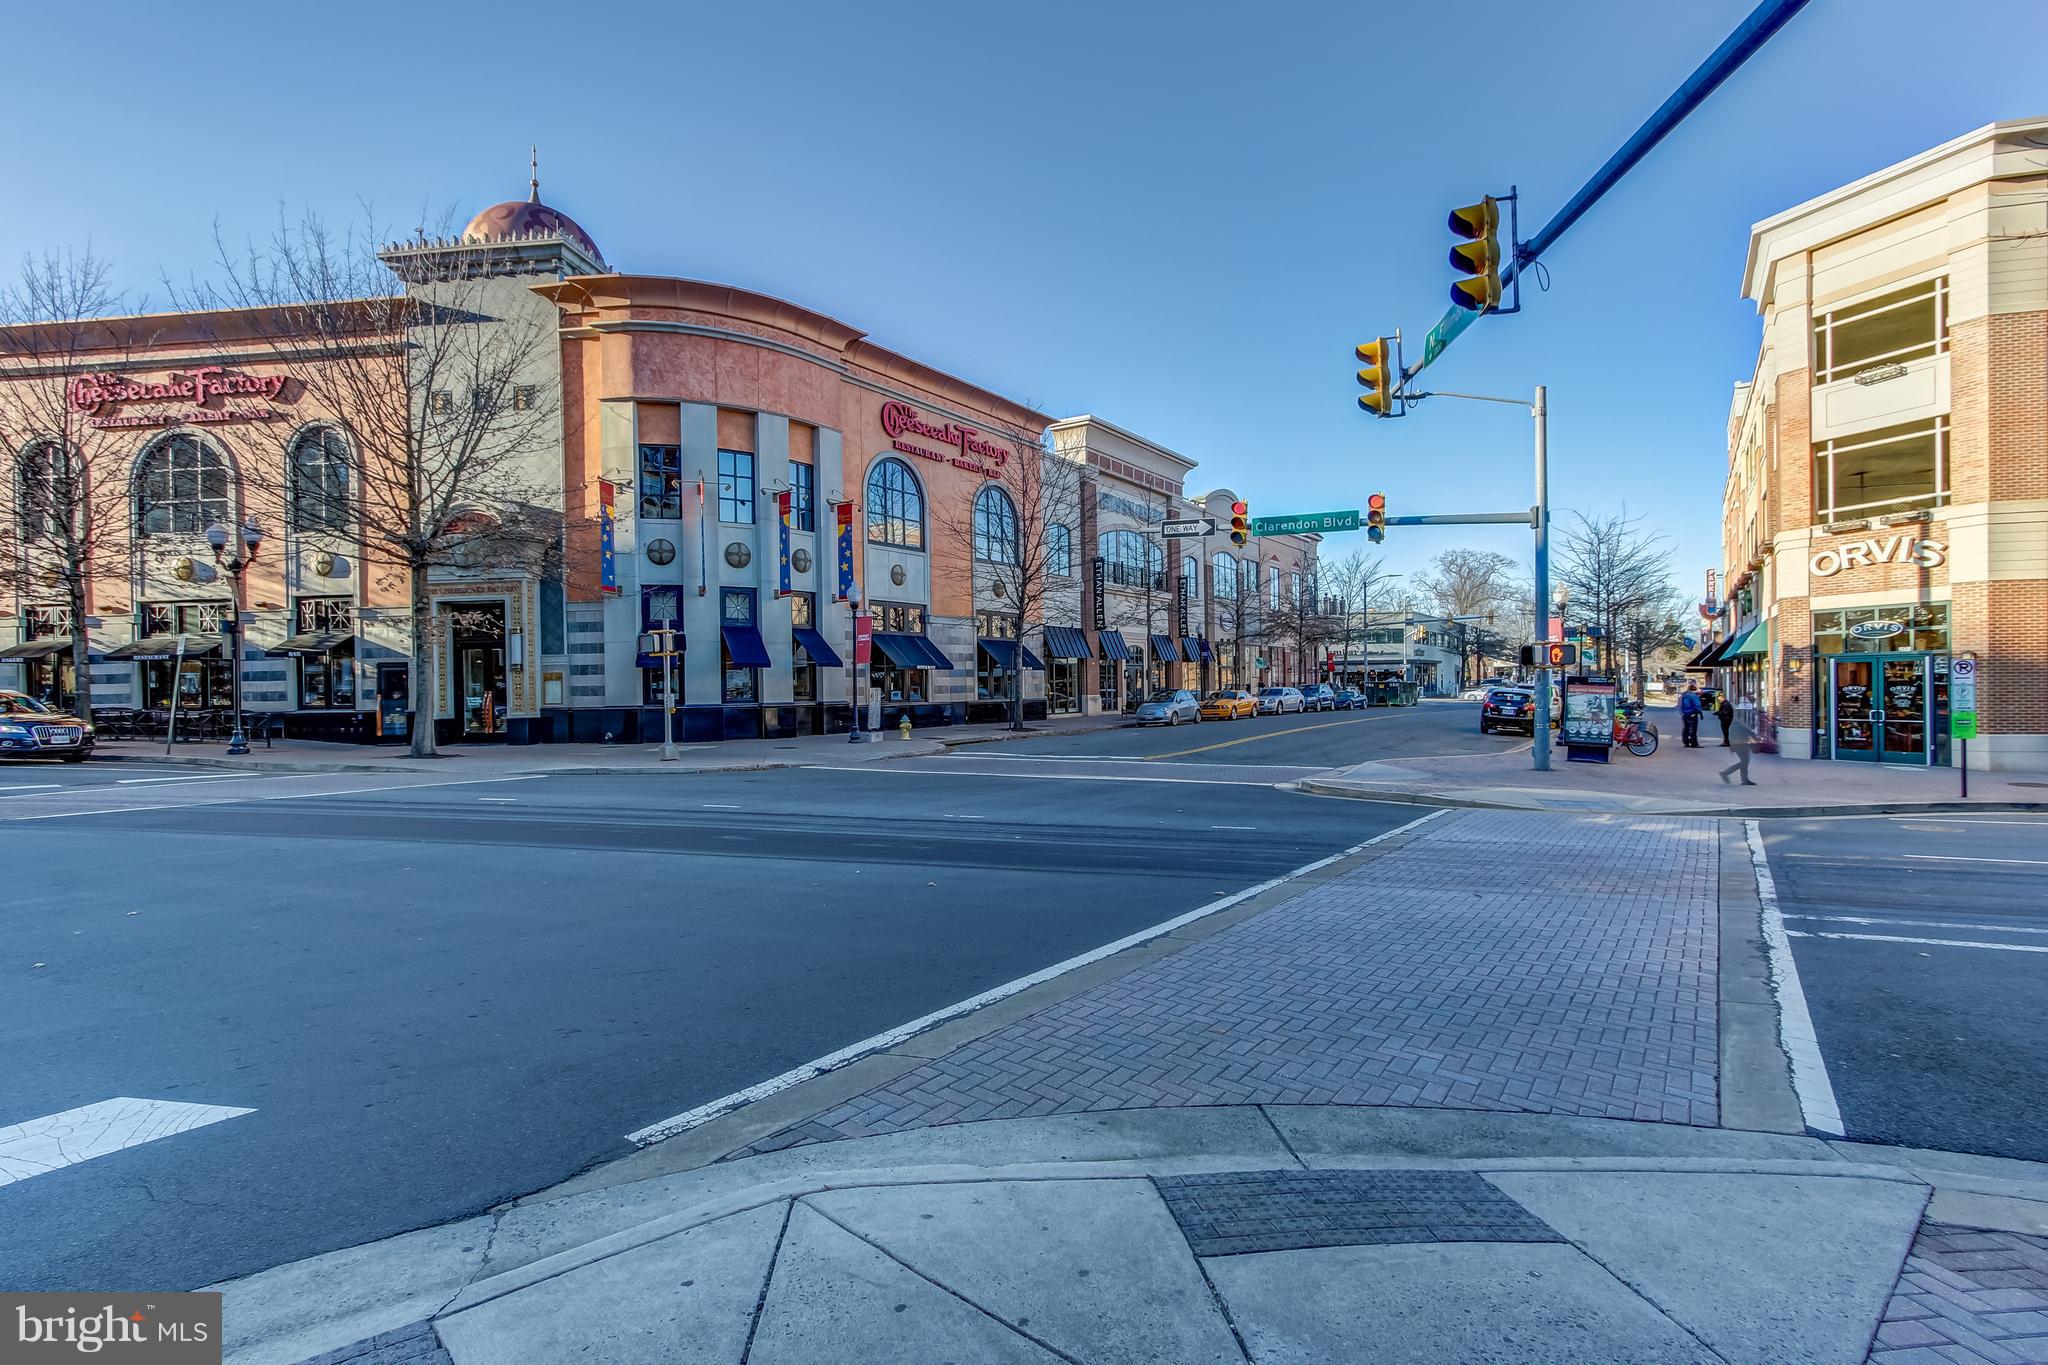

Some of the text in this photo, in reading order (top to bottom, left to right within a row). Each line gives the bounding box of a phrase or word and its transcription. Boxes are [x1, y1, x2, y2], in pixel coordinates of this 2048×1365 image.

[67, 366, 287, 413] Cheesecake Factory
[902, 405, 918, 418] The
[881, 400, 1009, 467] Cheesecake Factory
[893, 440, 945, 463] RESTAURANT
[1165, 524, 1198, 534] ONE WAY
[1255, 517, 1356, 532] Clarendon Blvd.
[1810, 535, 1945, 577] ORVIS
[1095, 561, 1104, 630] ETHAN ALLEN
[1852, 622, 1900, 633] ORVIS
